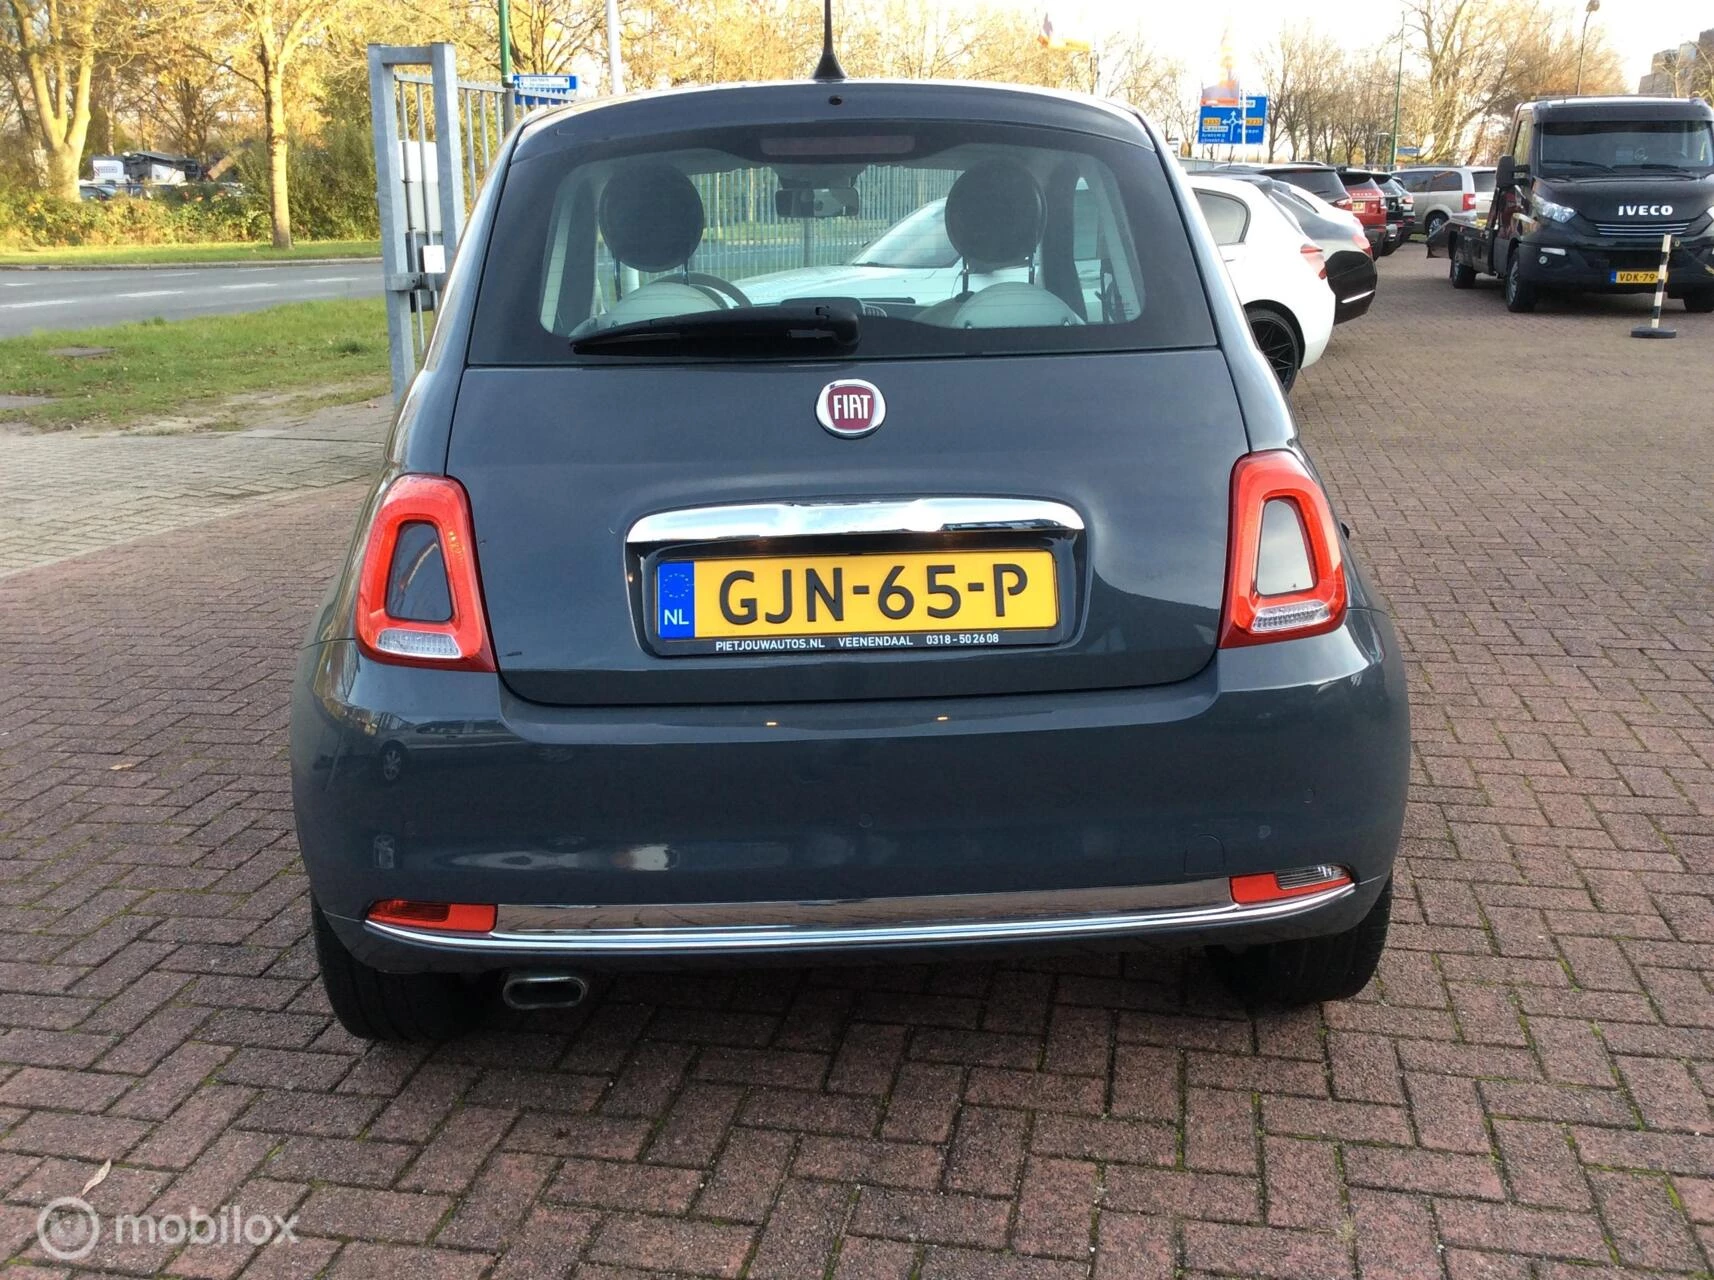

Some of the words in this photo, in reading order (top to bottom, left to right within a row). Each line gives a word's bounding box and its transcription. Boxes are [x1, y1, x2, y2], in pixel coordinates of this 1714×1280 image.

[1618, 205, 1674, 216] IVECO
[1619, 273, 1659, 282] VDK-79-
[833, 394, 871, 420] FIAT
[719, 563, 1028, 626] GJN-65-P
[664, 608, 690, 626] NL
[715, 638, 826, 651] PIETJOUWAUTOS.NL
[838, 635, 914, 647] VEENENDAAL
